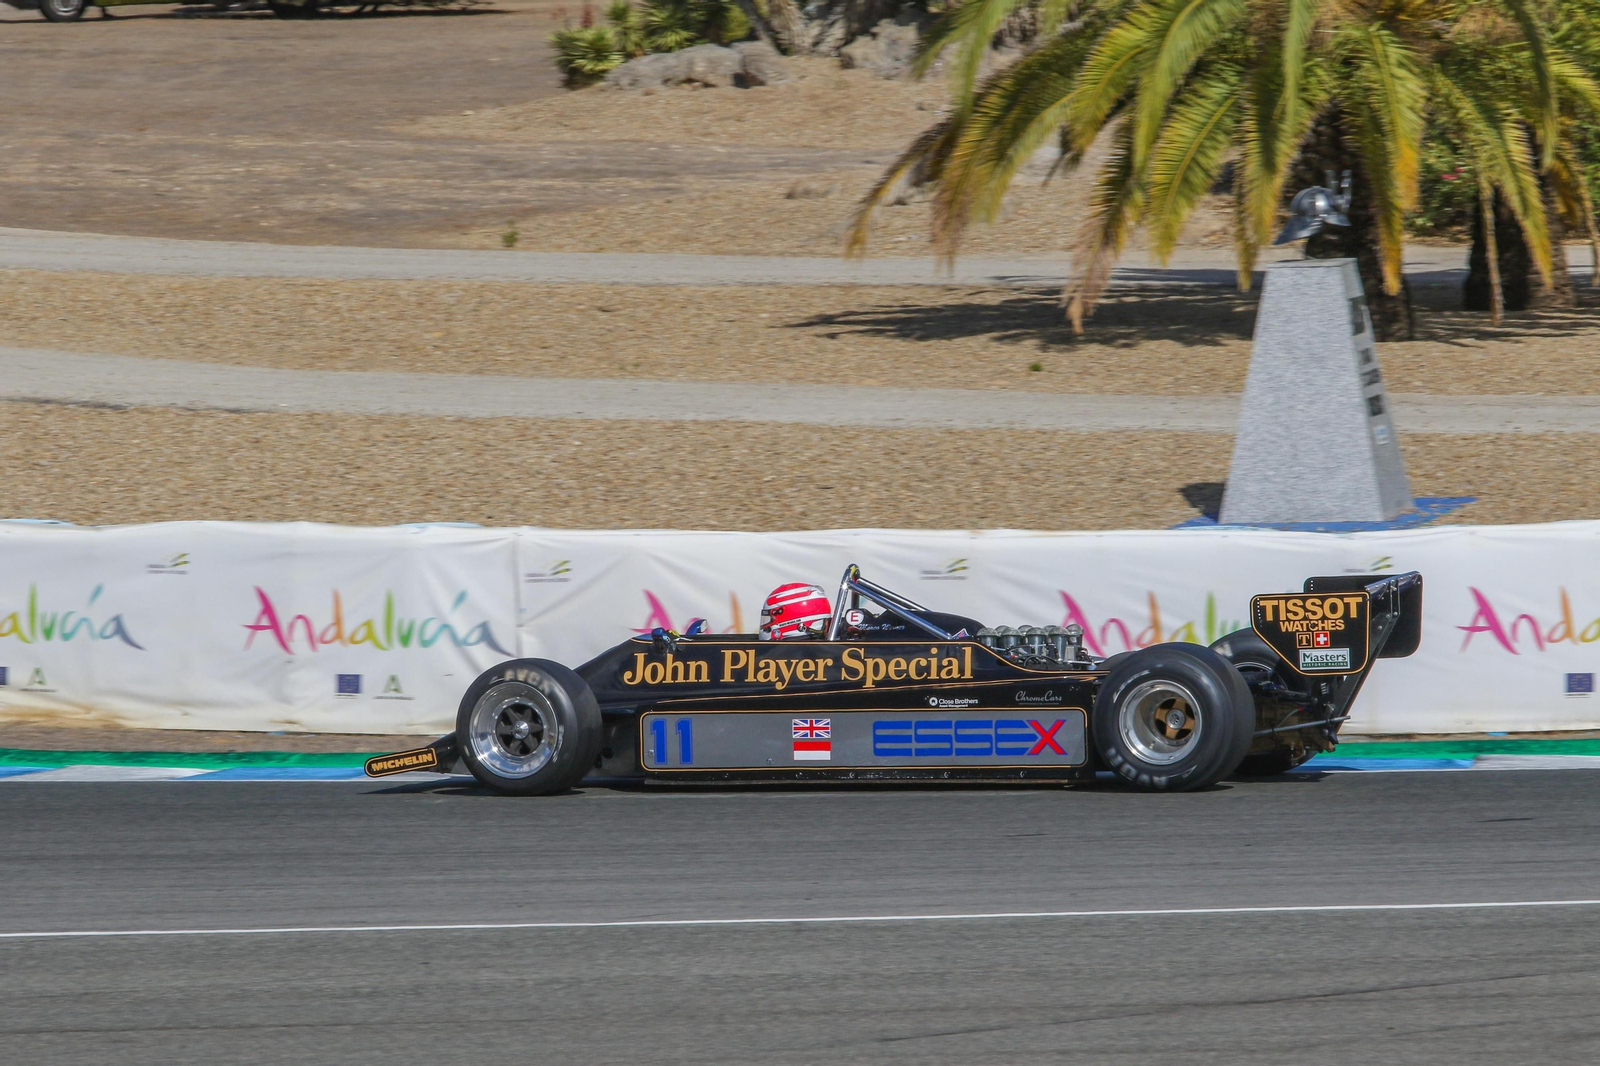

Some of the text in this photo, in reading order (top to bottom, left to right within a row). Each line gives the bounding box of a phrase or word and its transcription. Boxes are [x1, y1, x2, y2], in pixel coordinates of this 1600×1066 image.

[850, 610, 859, 622] E
[1259, 596, 1363, 621] TISSOT
[242, 585, 516, 657] Andalucía
[1280, 619, 1345, 632] WATCHES
[1299, 634, 1310, 646] T
[1302, 651, 1347, 663] Masters
[623, 646, 974, 690] John Player Special
[1015, 690, 1062, 702] ChromeCars
[651, 717, 693, 765] 11
[873, 719, 1067, 757] ESSEX
[371, 753, 433, 771] MICHELIN
